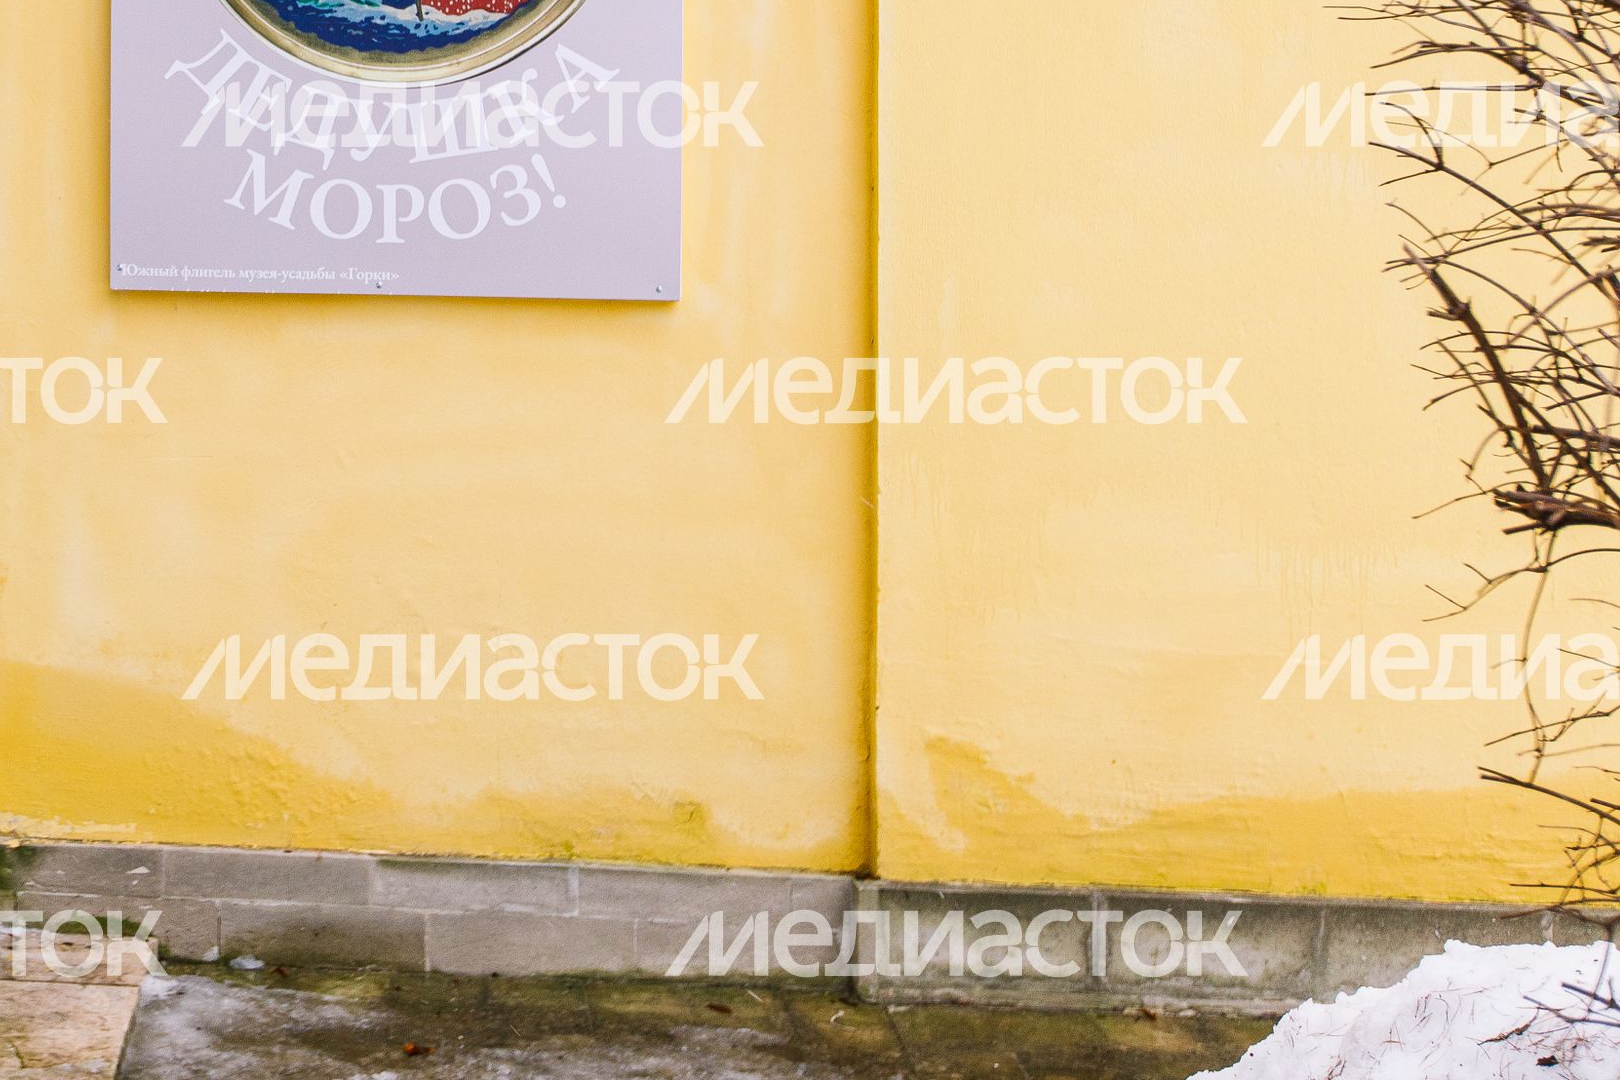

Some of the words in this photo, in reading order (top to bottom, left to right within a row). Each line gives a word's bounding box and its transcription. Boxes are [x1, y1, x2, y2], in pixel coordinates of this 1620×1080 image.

[164, 28, 621, 171] ДЕДУШКА
[223, 148, 567, 244] МОРОЗ!
[120, 263, 178, 278] Южный
[180, 264, 236, 281] флигель
[239, 267, 335, 282] музея-усадьбы
[340, 266, 400, 284] «Горки»
